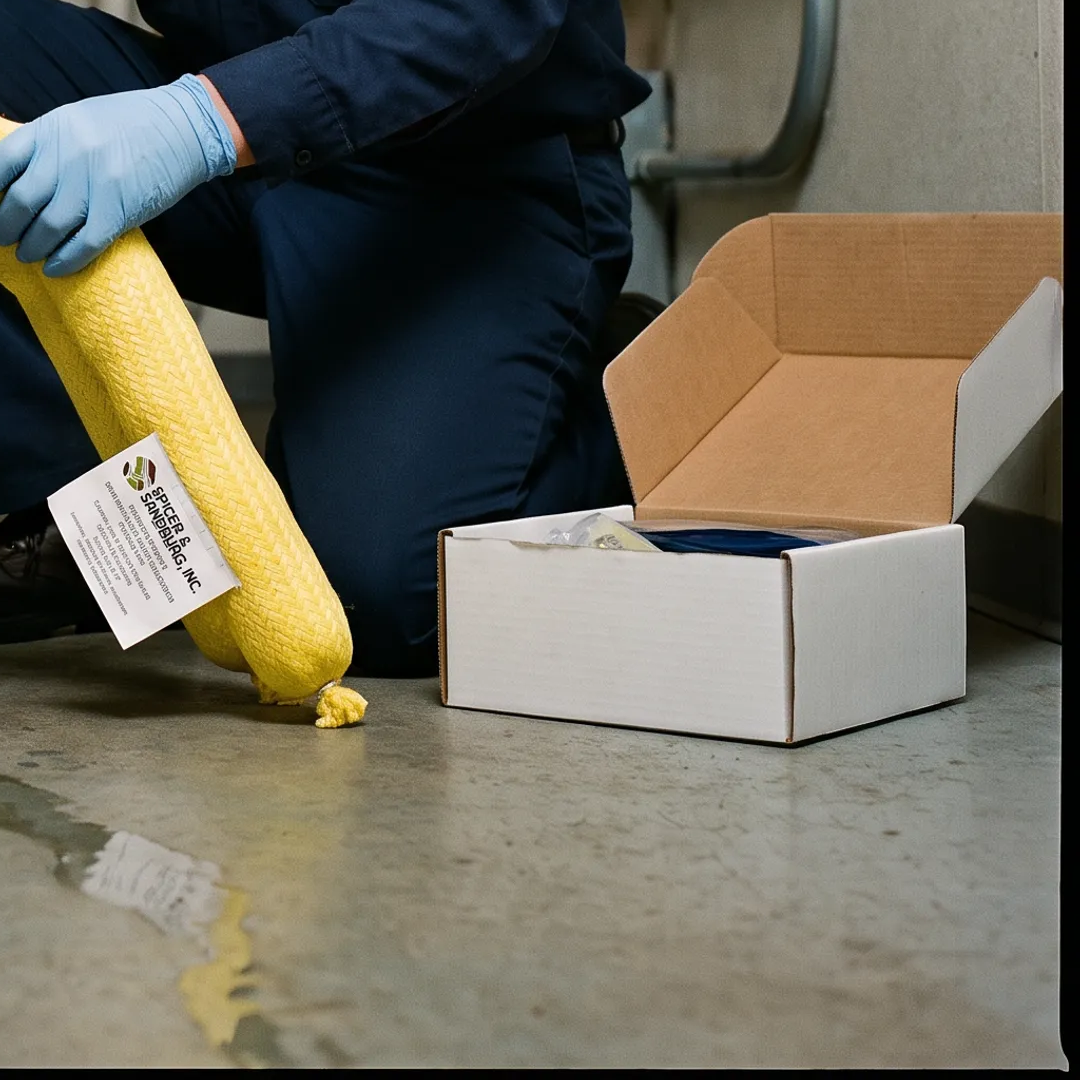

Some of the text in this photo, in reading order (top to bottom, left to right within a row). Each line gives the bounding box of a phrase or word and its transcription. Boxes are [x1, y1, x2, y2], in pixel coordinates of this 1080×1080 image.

[151, 486, 191, 549] SPICER &
[181, 566, 203, 595] INC.
